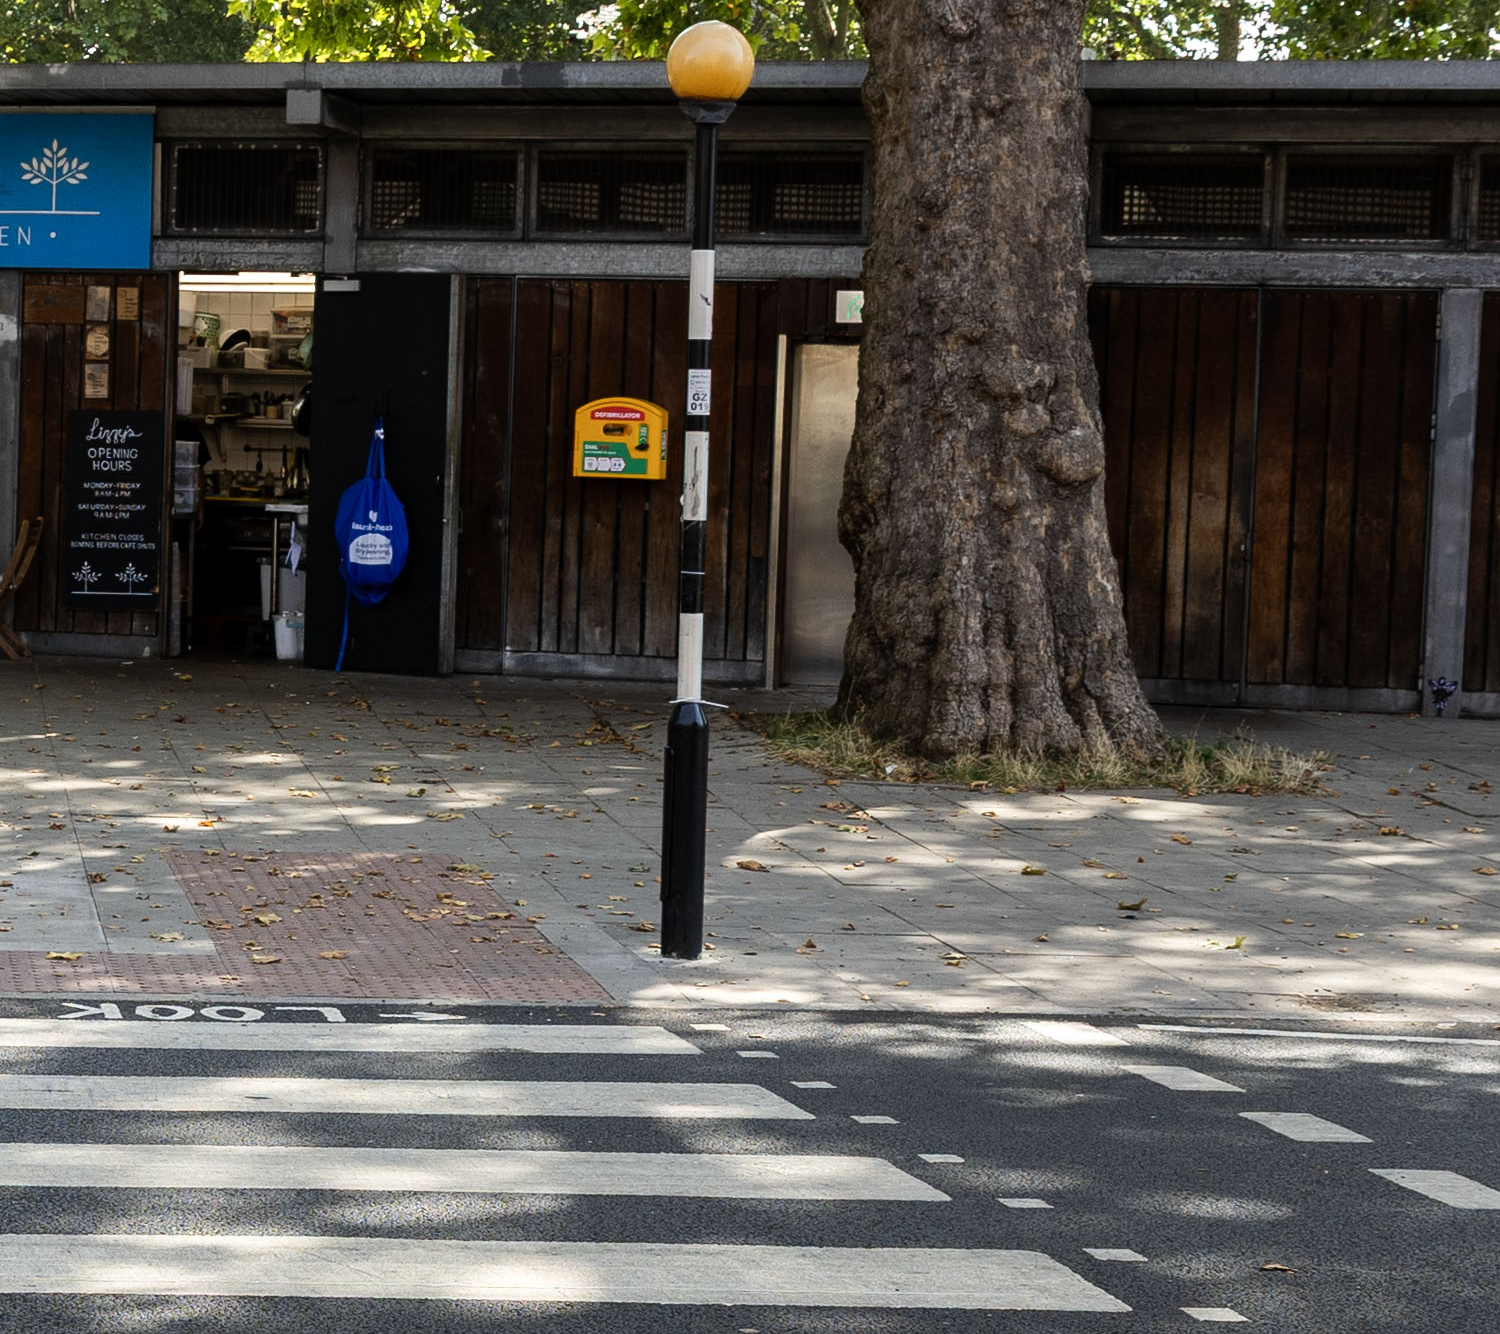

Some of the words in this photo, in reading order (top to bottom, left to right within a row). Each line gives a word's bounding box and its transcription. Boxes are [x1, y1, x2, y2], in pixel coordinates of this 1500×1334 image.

[692, 392, 708, 402] GZ
[594, 411, 641, 419] DEFIBRILLATOR
[85, 417, 143, 444] Lizzy's
[87, 447, 139, 459] OPENING
[92, 460, 133, 472] HOURS
[81, 533, 117, 541] KITCHEN
[119, 534, 144, 542] CLOSES
[57, 1002, 347, 1023] LOOK
